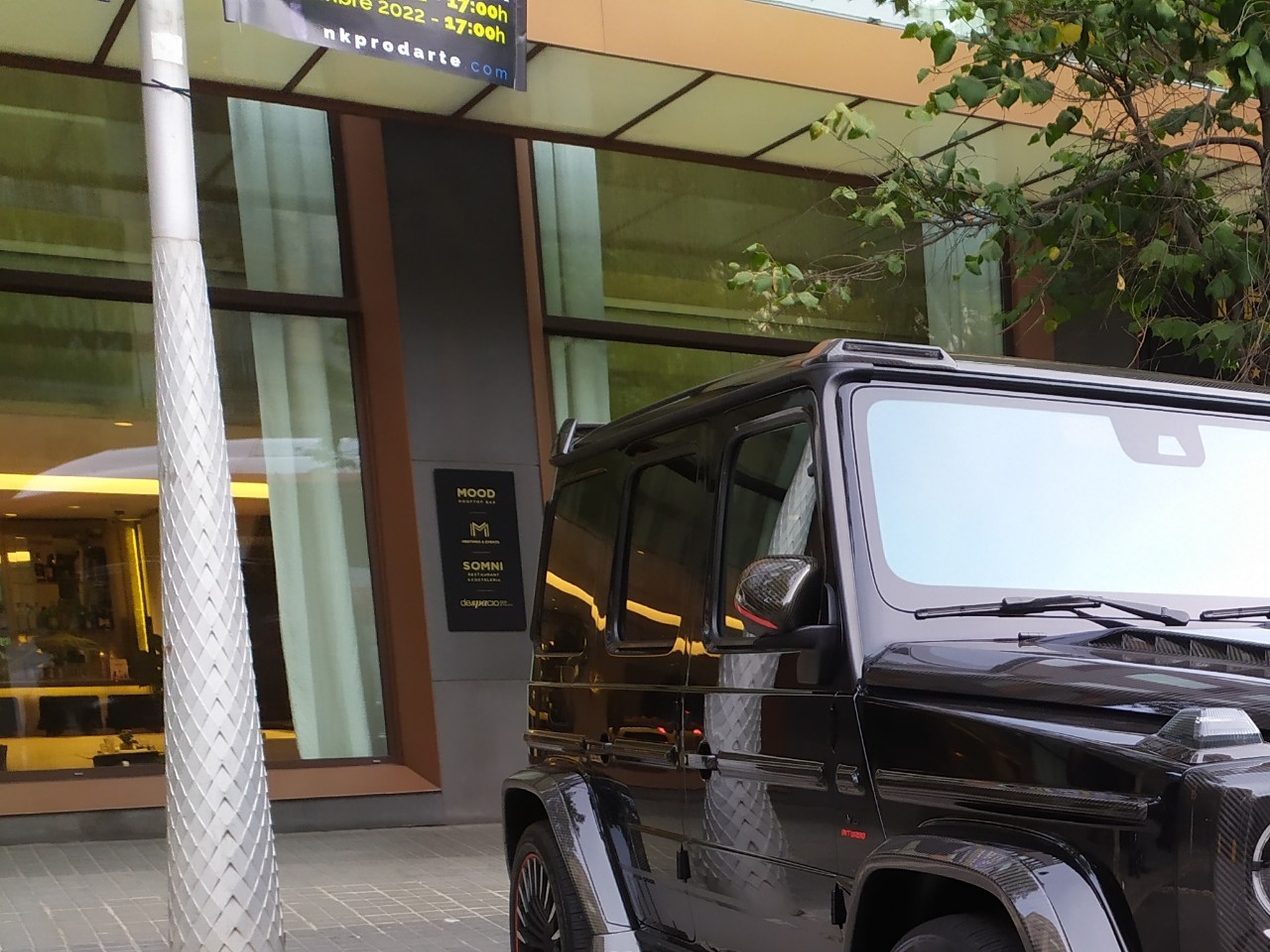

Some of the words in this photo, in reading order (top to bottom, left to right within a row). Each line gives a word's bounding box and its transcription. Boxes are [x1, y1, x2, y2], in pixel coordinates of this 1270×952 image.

[378, 0, 425, 24] 2022
[444, 15, 505, 44] 17:00h
[457, 488, 496, 498] MOOD
[463, 561, 504, 571] SOMNI
